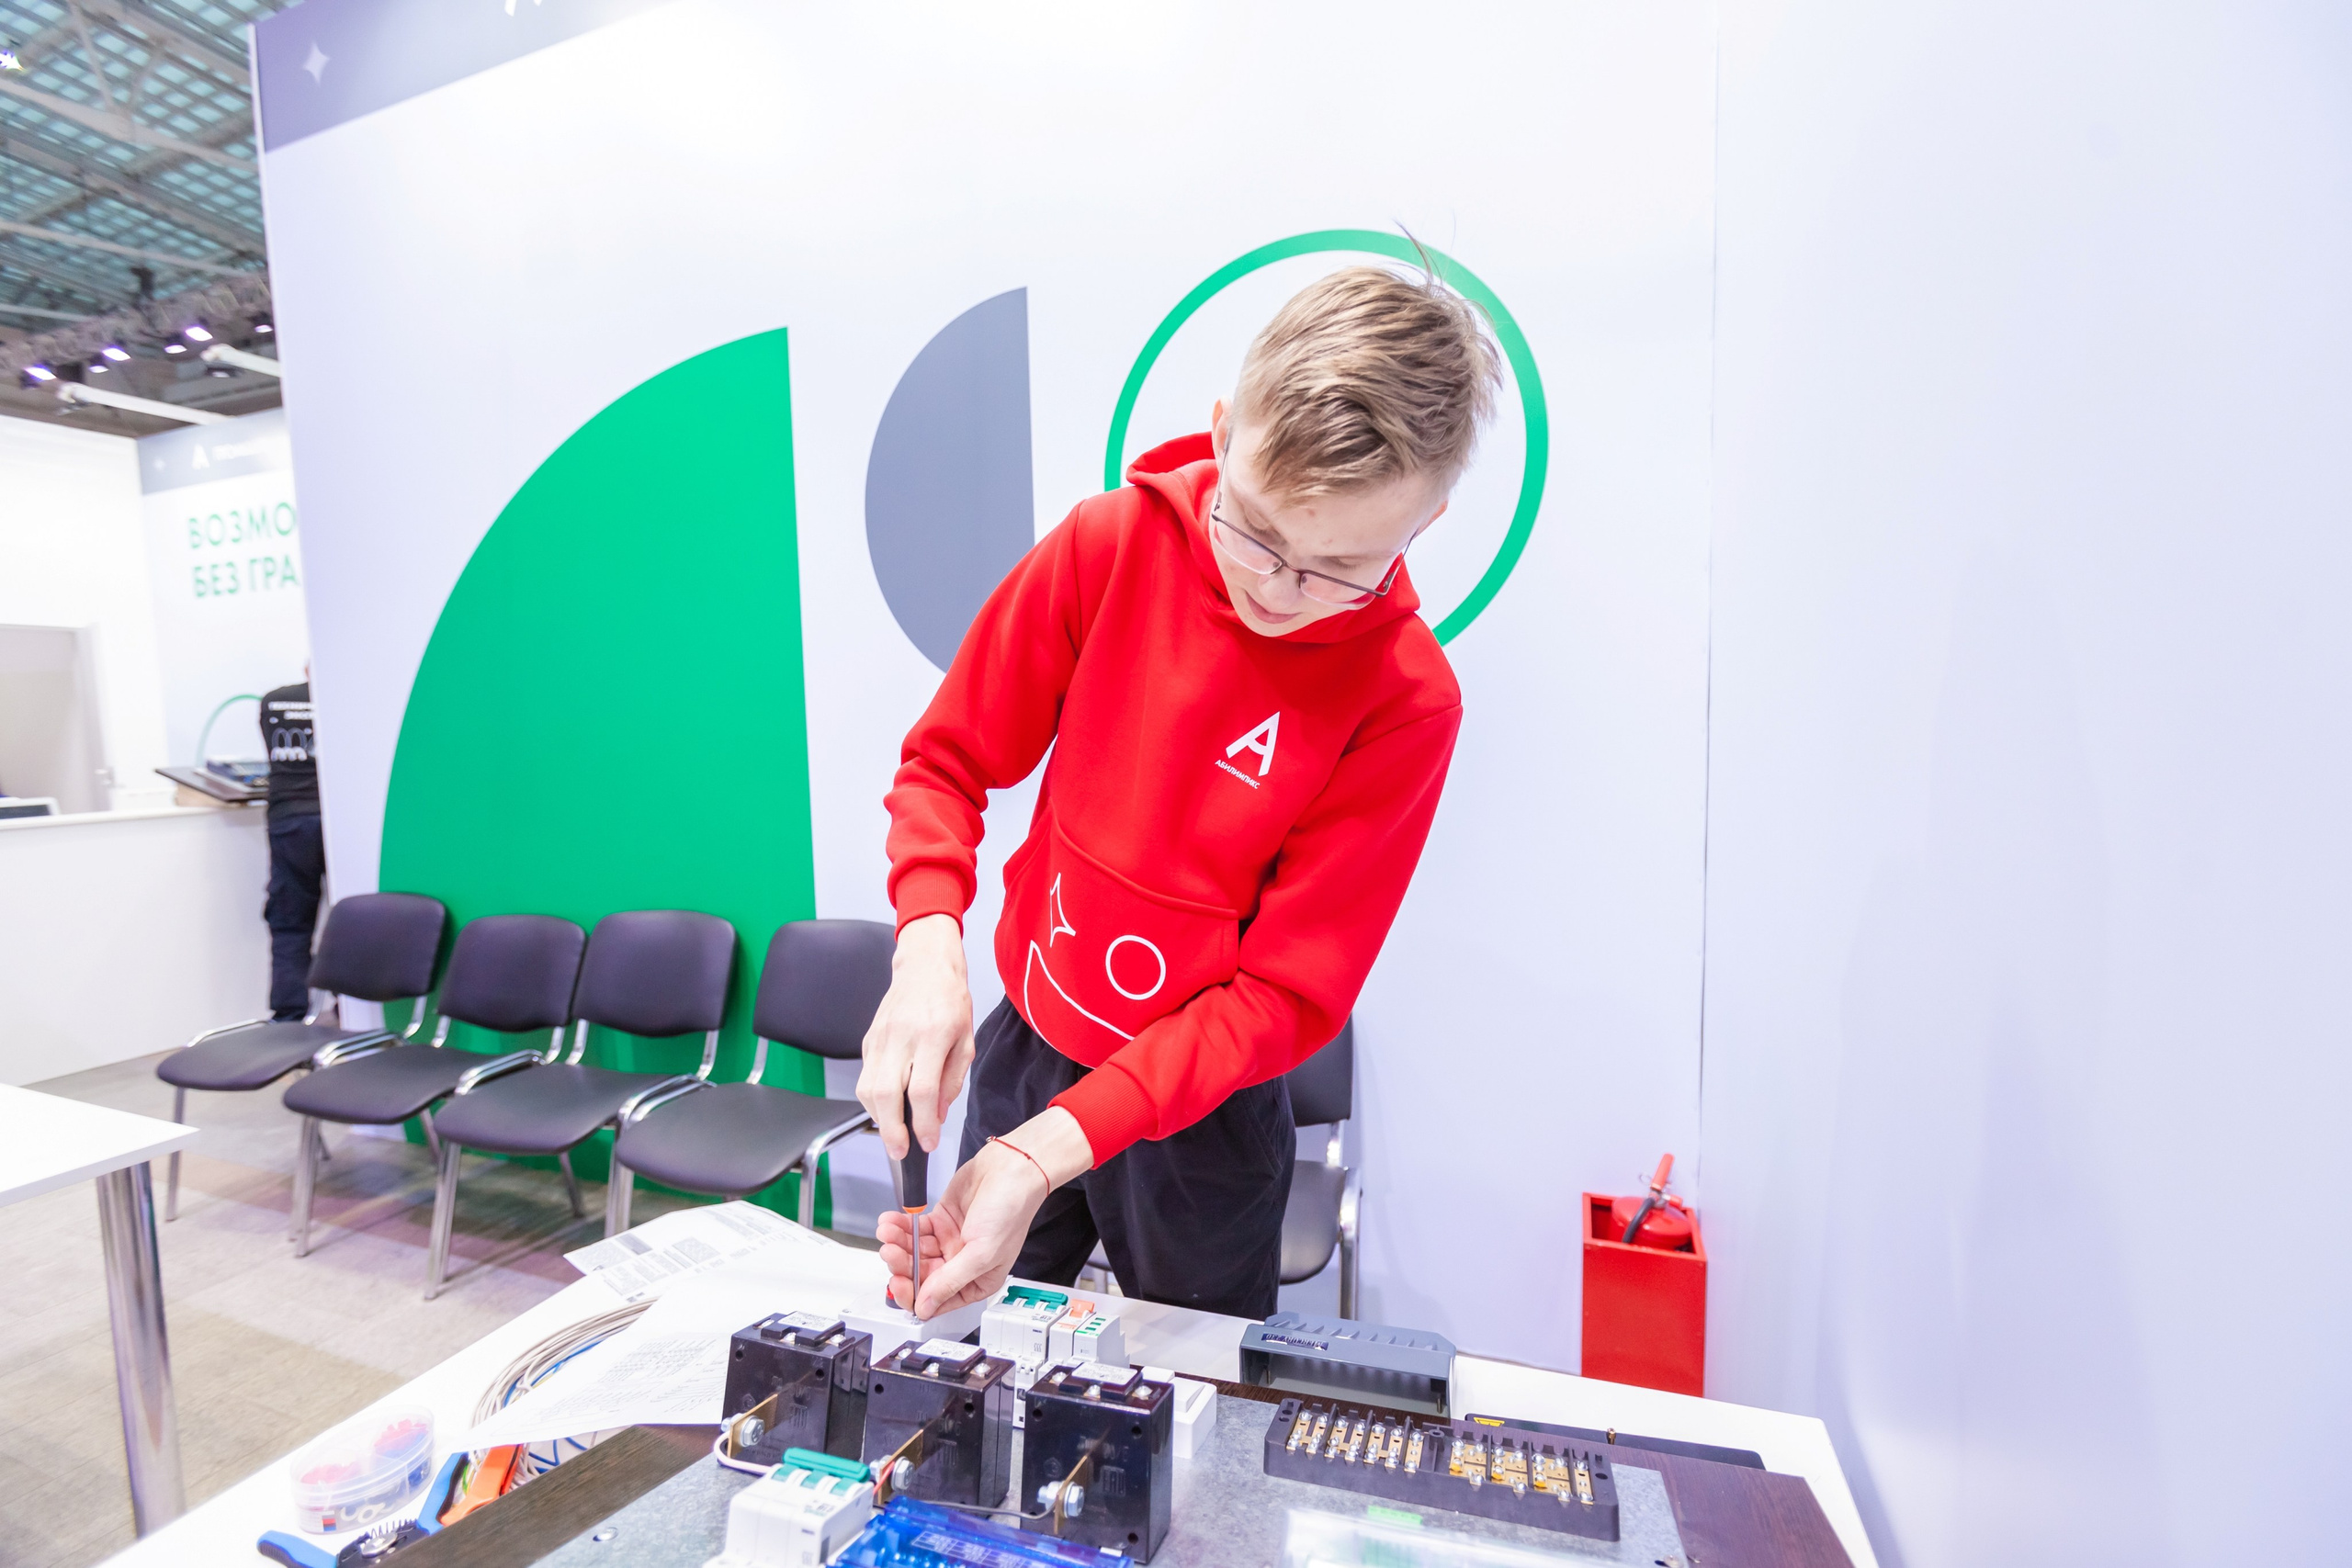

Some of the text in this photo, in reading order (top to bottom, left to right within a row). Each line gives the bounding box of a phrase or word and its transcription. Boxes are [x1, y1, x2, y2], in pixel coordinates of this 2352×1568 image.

[188, 502, 298, 548] ВОЗМО
[191, 554, 301, 598] БЕЗ ГРА
[1214, 759, 1261, 790] АБИЛИМПИКС
